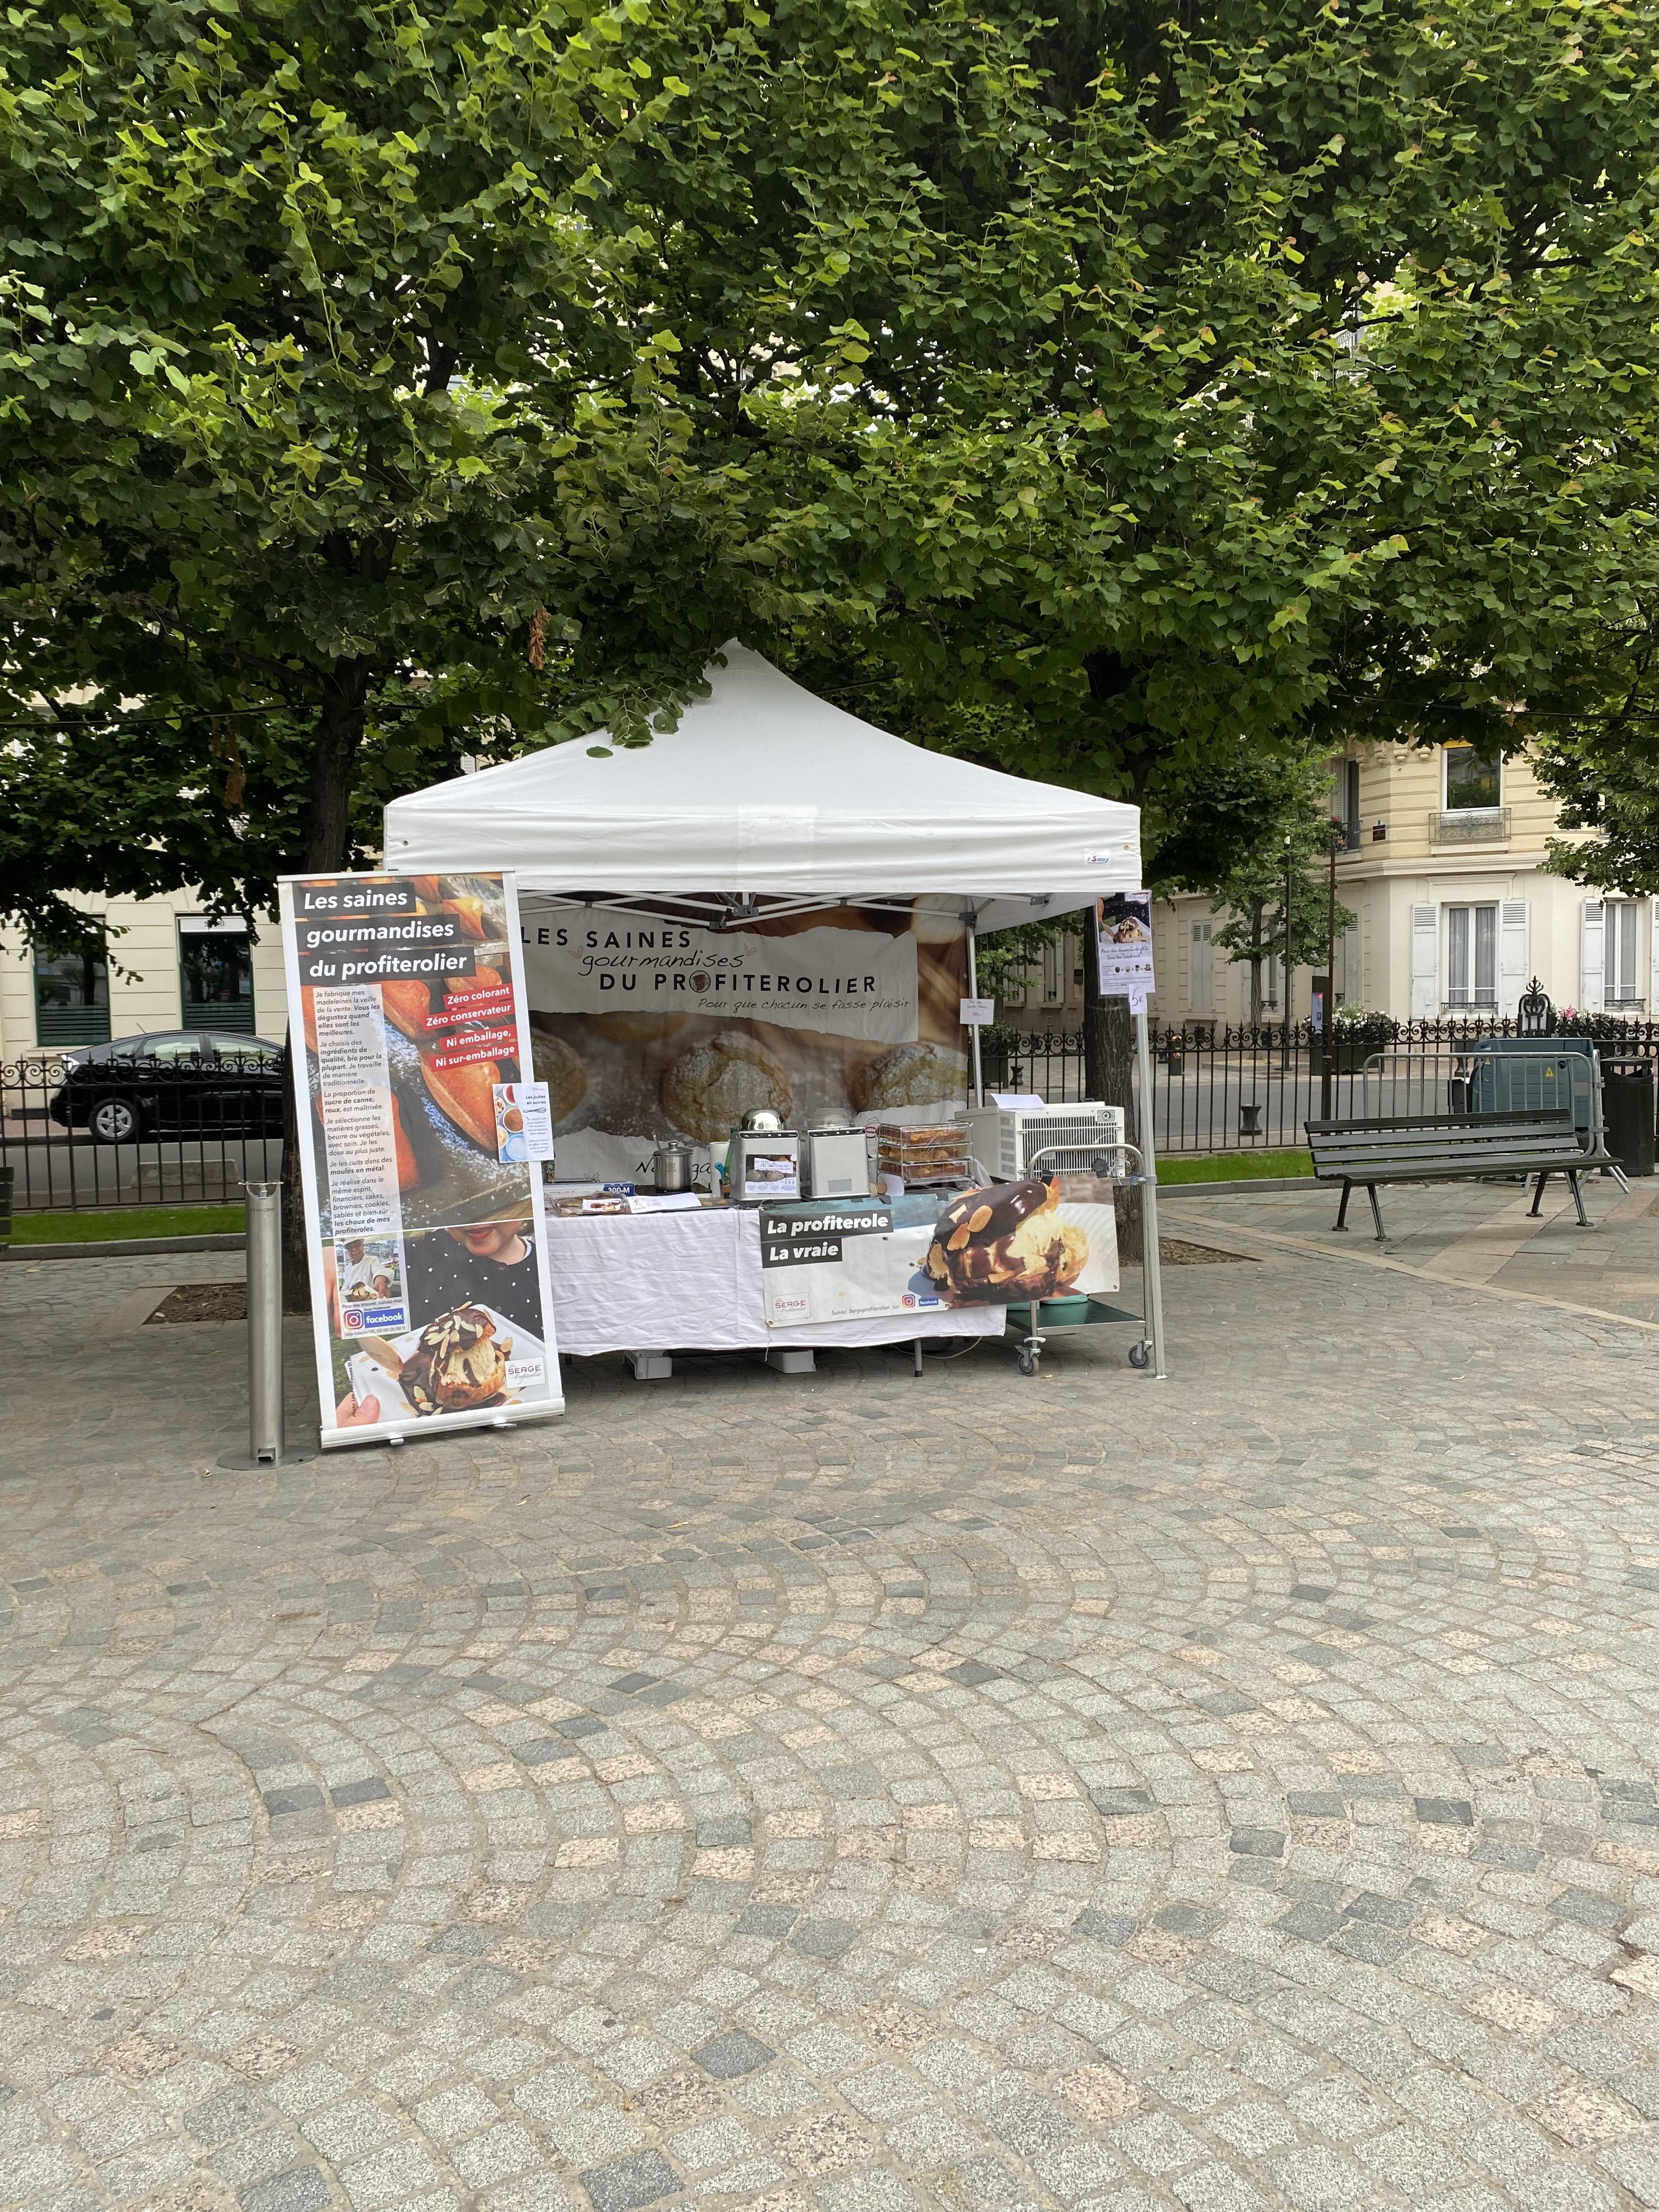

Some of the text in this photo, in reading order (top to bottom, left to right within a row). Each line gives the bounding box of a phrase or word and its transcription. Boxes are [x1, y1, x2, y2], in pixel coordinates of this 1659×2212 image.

[304, 889, 408, 910] Les saines
[307, 921, 454, 948] gourmandises
[521, 926, 691, 949] LES SAINES
[309, 953, 467, 980] du profiterolier
[578, 950, 744, 976] gourmandises
[600, 973, 636, 991] DU
[448, 986, 510, 1005] Zéro colorant
[697, 997, 729, 1009] Pour
[733, 1000, 757, 1014] que
[761, 998, 807, 1009] chacun
[832, 998, 866, 1010] fasse
[869, 997, 910, 1012] plaisir
[349, 1012, 370, 1020] quand
[426, 1005, 511, 1026] Zéro conservateur
[446, 1030, 511, 1048] Ni emballage,
[320, 1048, 357, 1056] ingrédients
[436, 1046, 515, 1068] Ni sur-emballage
[359, 1130, 390, 1138] végétales,
[335, 1226, 375, 1236] profiteroles.
[768, 1213, 888, 1237] La profiterole
[770, 1242, 838, 1261] La vraie
[775, 1300, 806, 1308] SERGE
[849, 1305, 890, 1314] Sergeprofiterolier
[366, 1312, 403, 1324] facebook
[508, 1364, 541, 1375] SERGE
